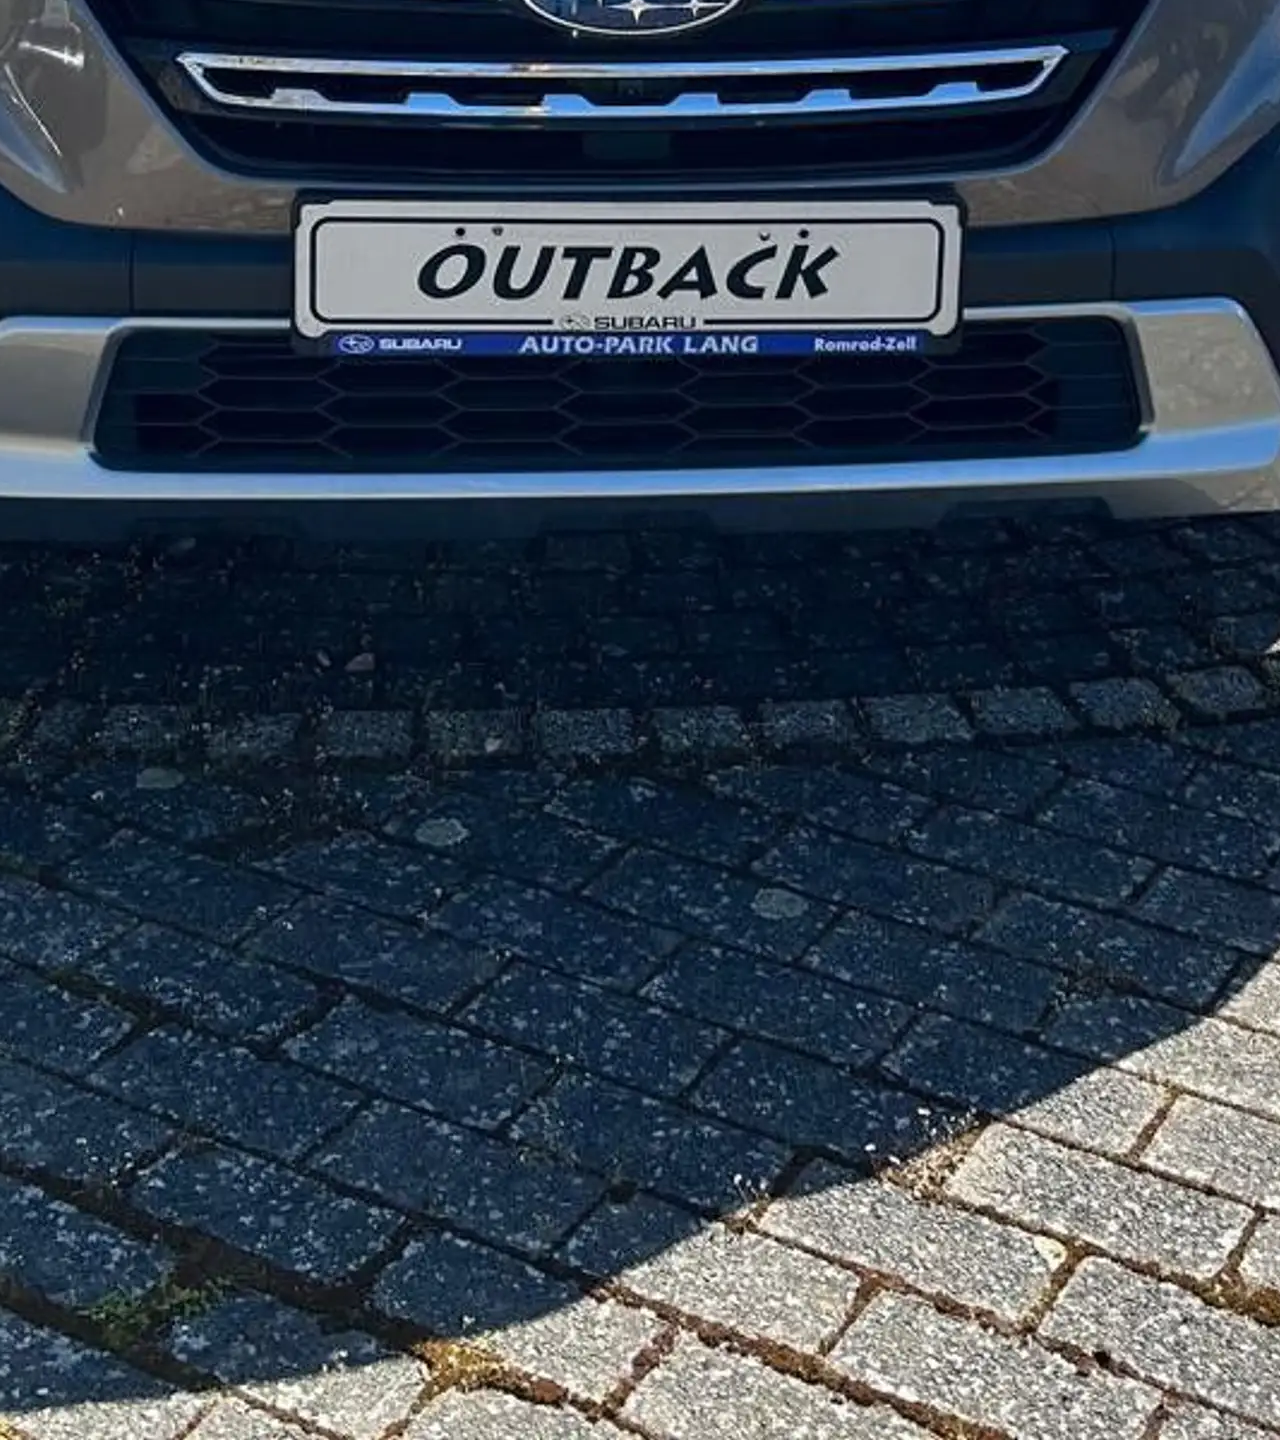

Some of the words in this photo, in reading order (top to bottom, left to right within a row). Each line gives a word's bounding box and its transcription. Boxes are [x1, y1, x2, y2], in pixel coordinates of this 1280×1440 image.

[416, 242, 841, 301] OUTBACK
[593, 315, 697, 330] SUBARU
[378, 336, 463, 351] SUBARU
[519, 334, 675, 356] AUTO-PARK
[683, 334, 760, 355] LANG
